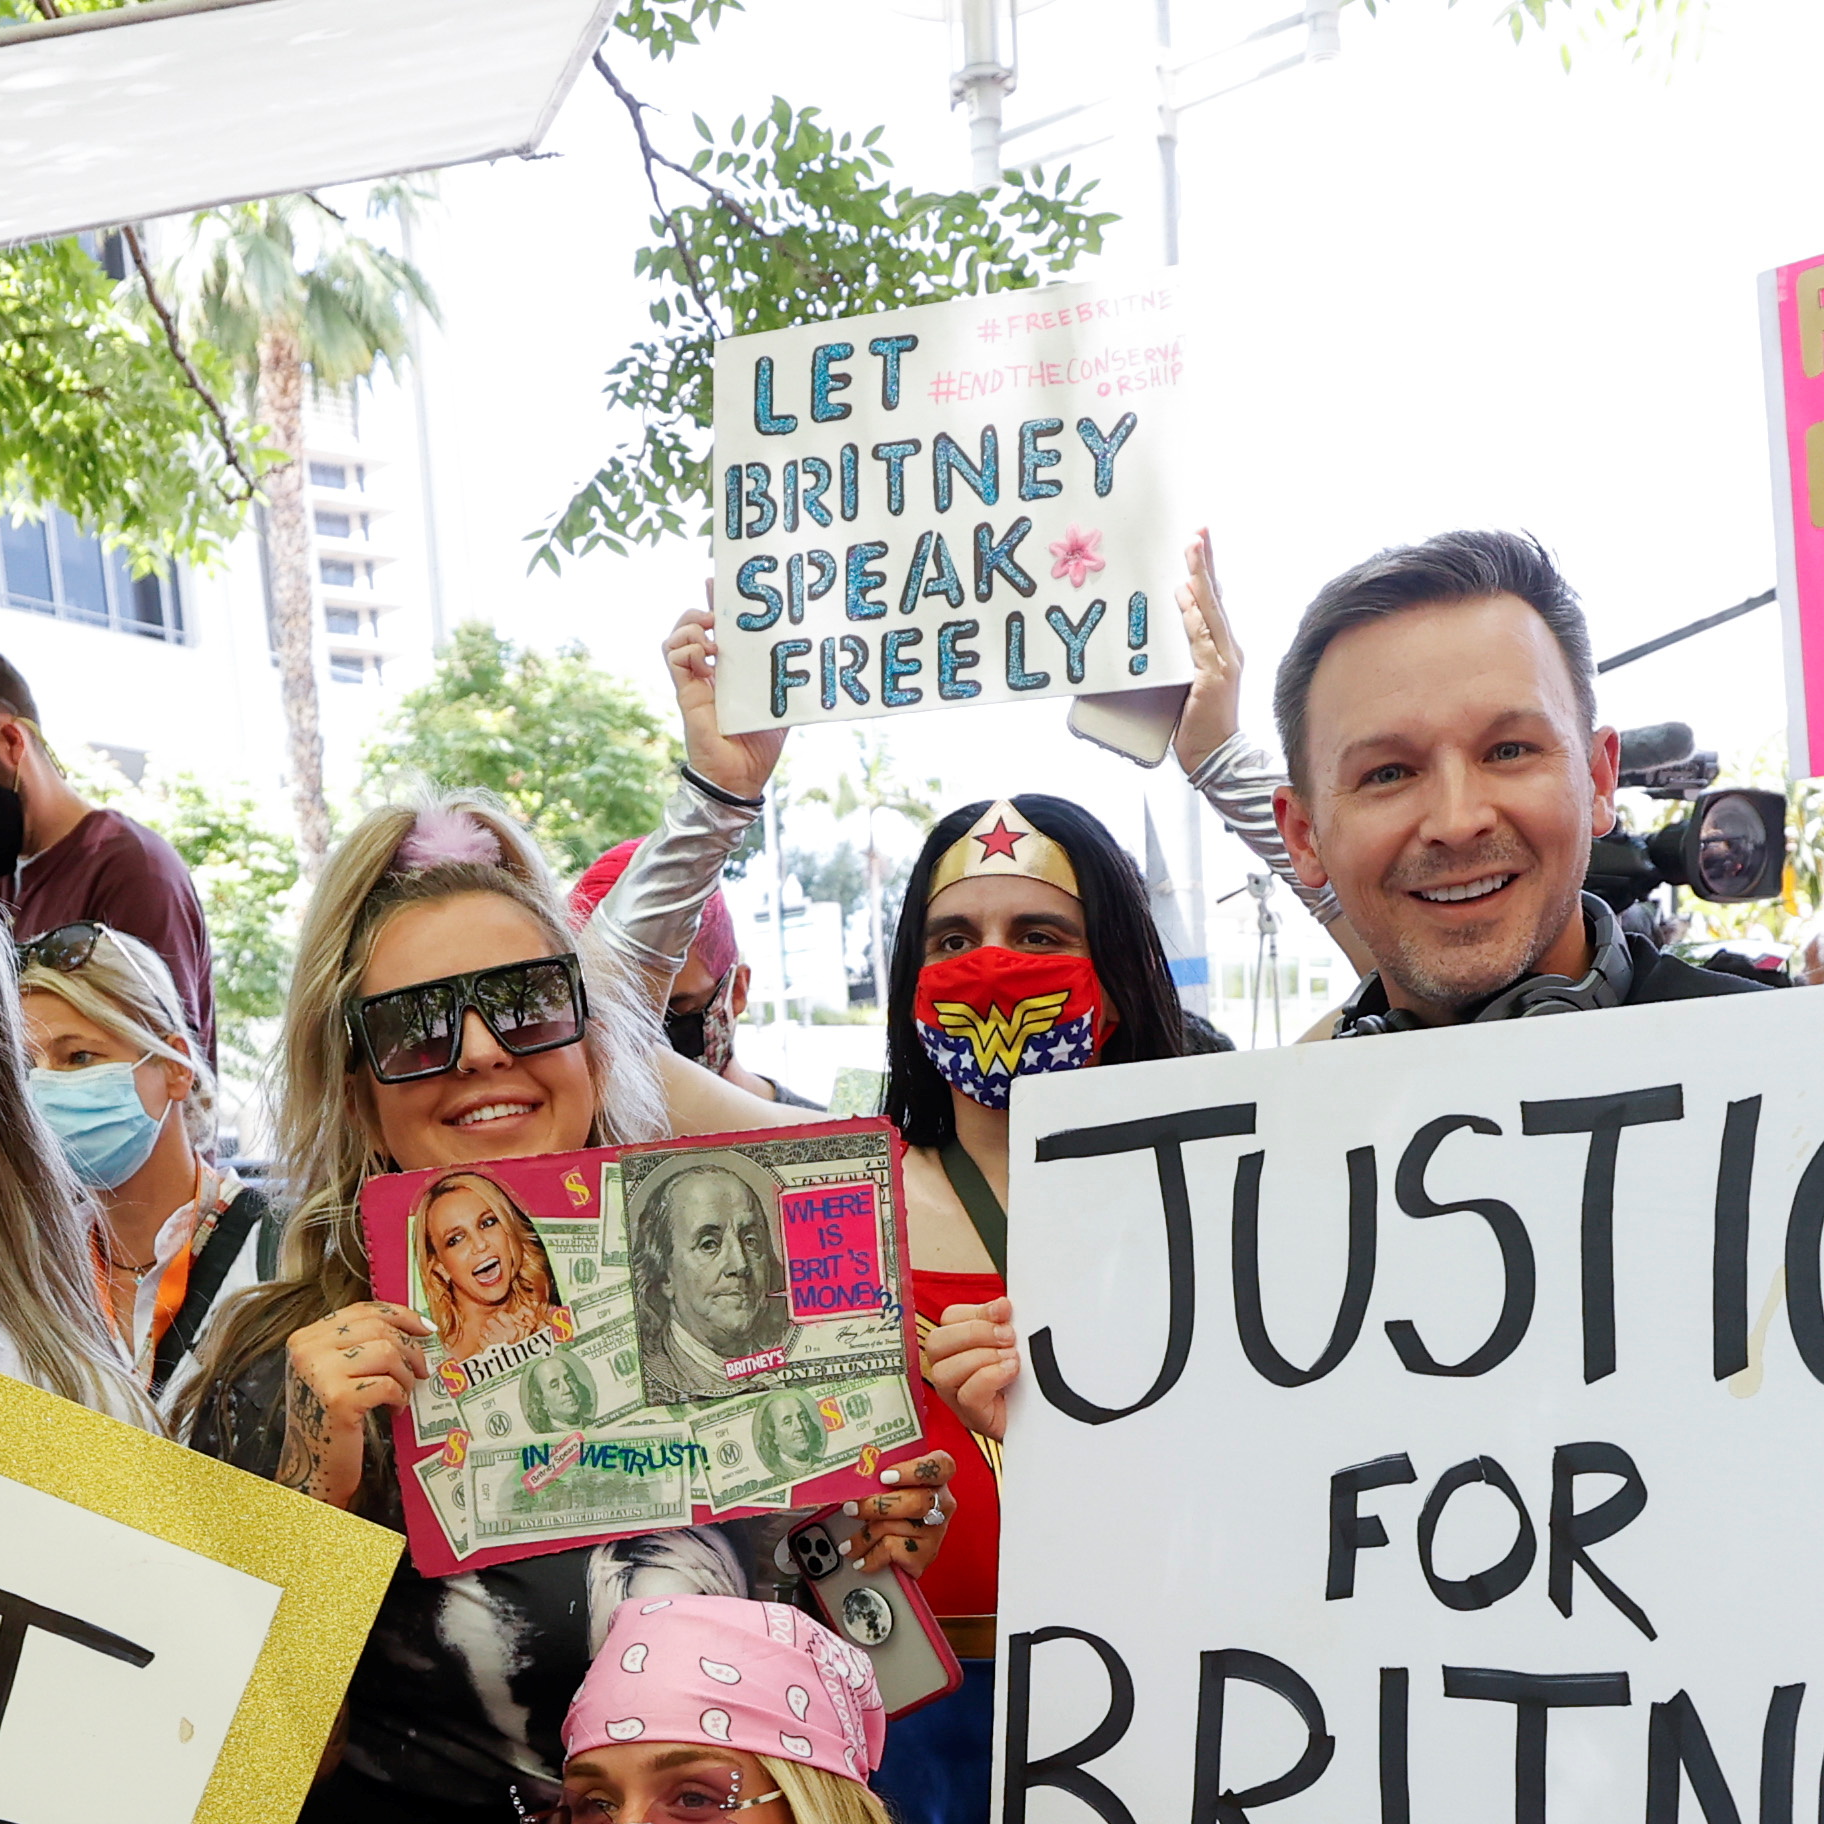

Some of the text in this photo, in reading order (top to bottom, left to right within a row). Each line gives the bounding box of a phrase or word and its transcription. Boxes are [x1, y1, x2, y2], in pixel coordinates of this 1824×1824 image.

[753, 334, 919, 435] LET
[725, 412, 1138, 539] BRITNEY
[736, 515, 1037, 631] SPEAK
[770, 590, 1149, 718] FREELY!
[785, 1192, 872, 1223] WHERE
[817, 1224, 843, 1249] IS
[462, 1328, 553, 1387] Britney
[726, 1350, 785, 1378] BRITNEY'S
[777, 1365, 822, 1381] ONE
[873, 1417, 906, 1435] 100
[522, 1443, 549, 1470] IN
[553, 1443, 578, 1464] Spears
[1326, 1441, 1657, 1640] FOR
